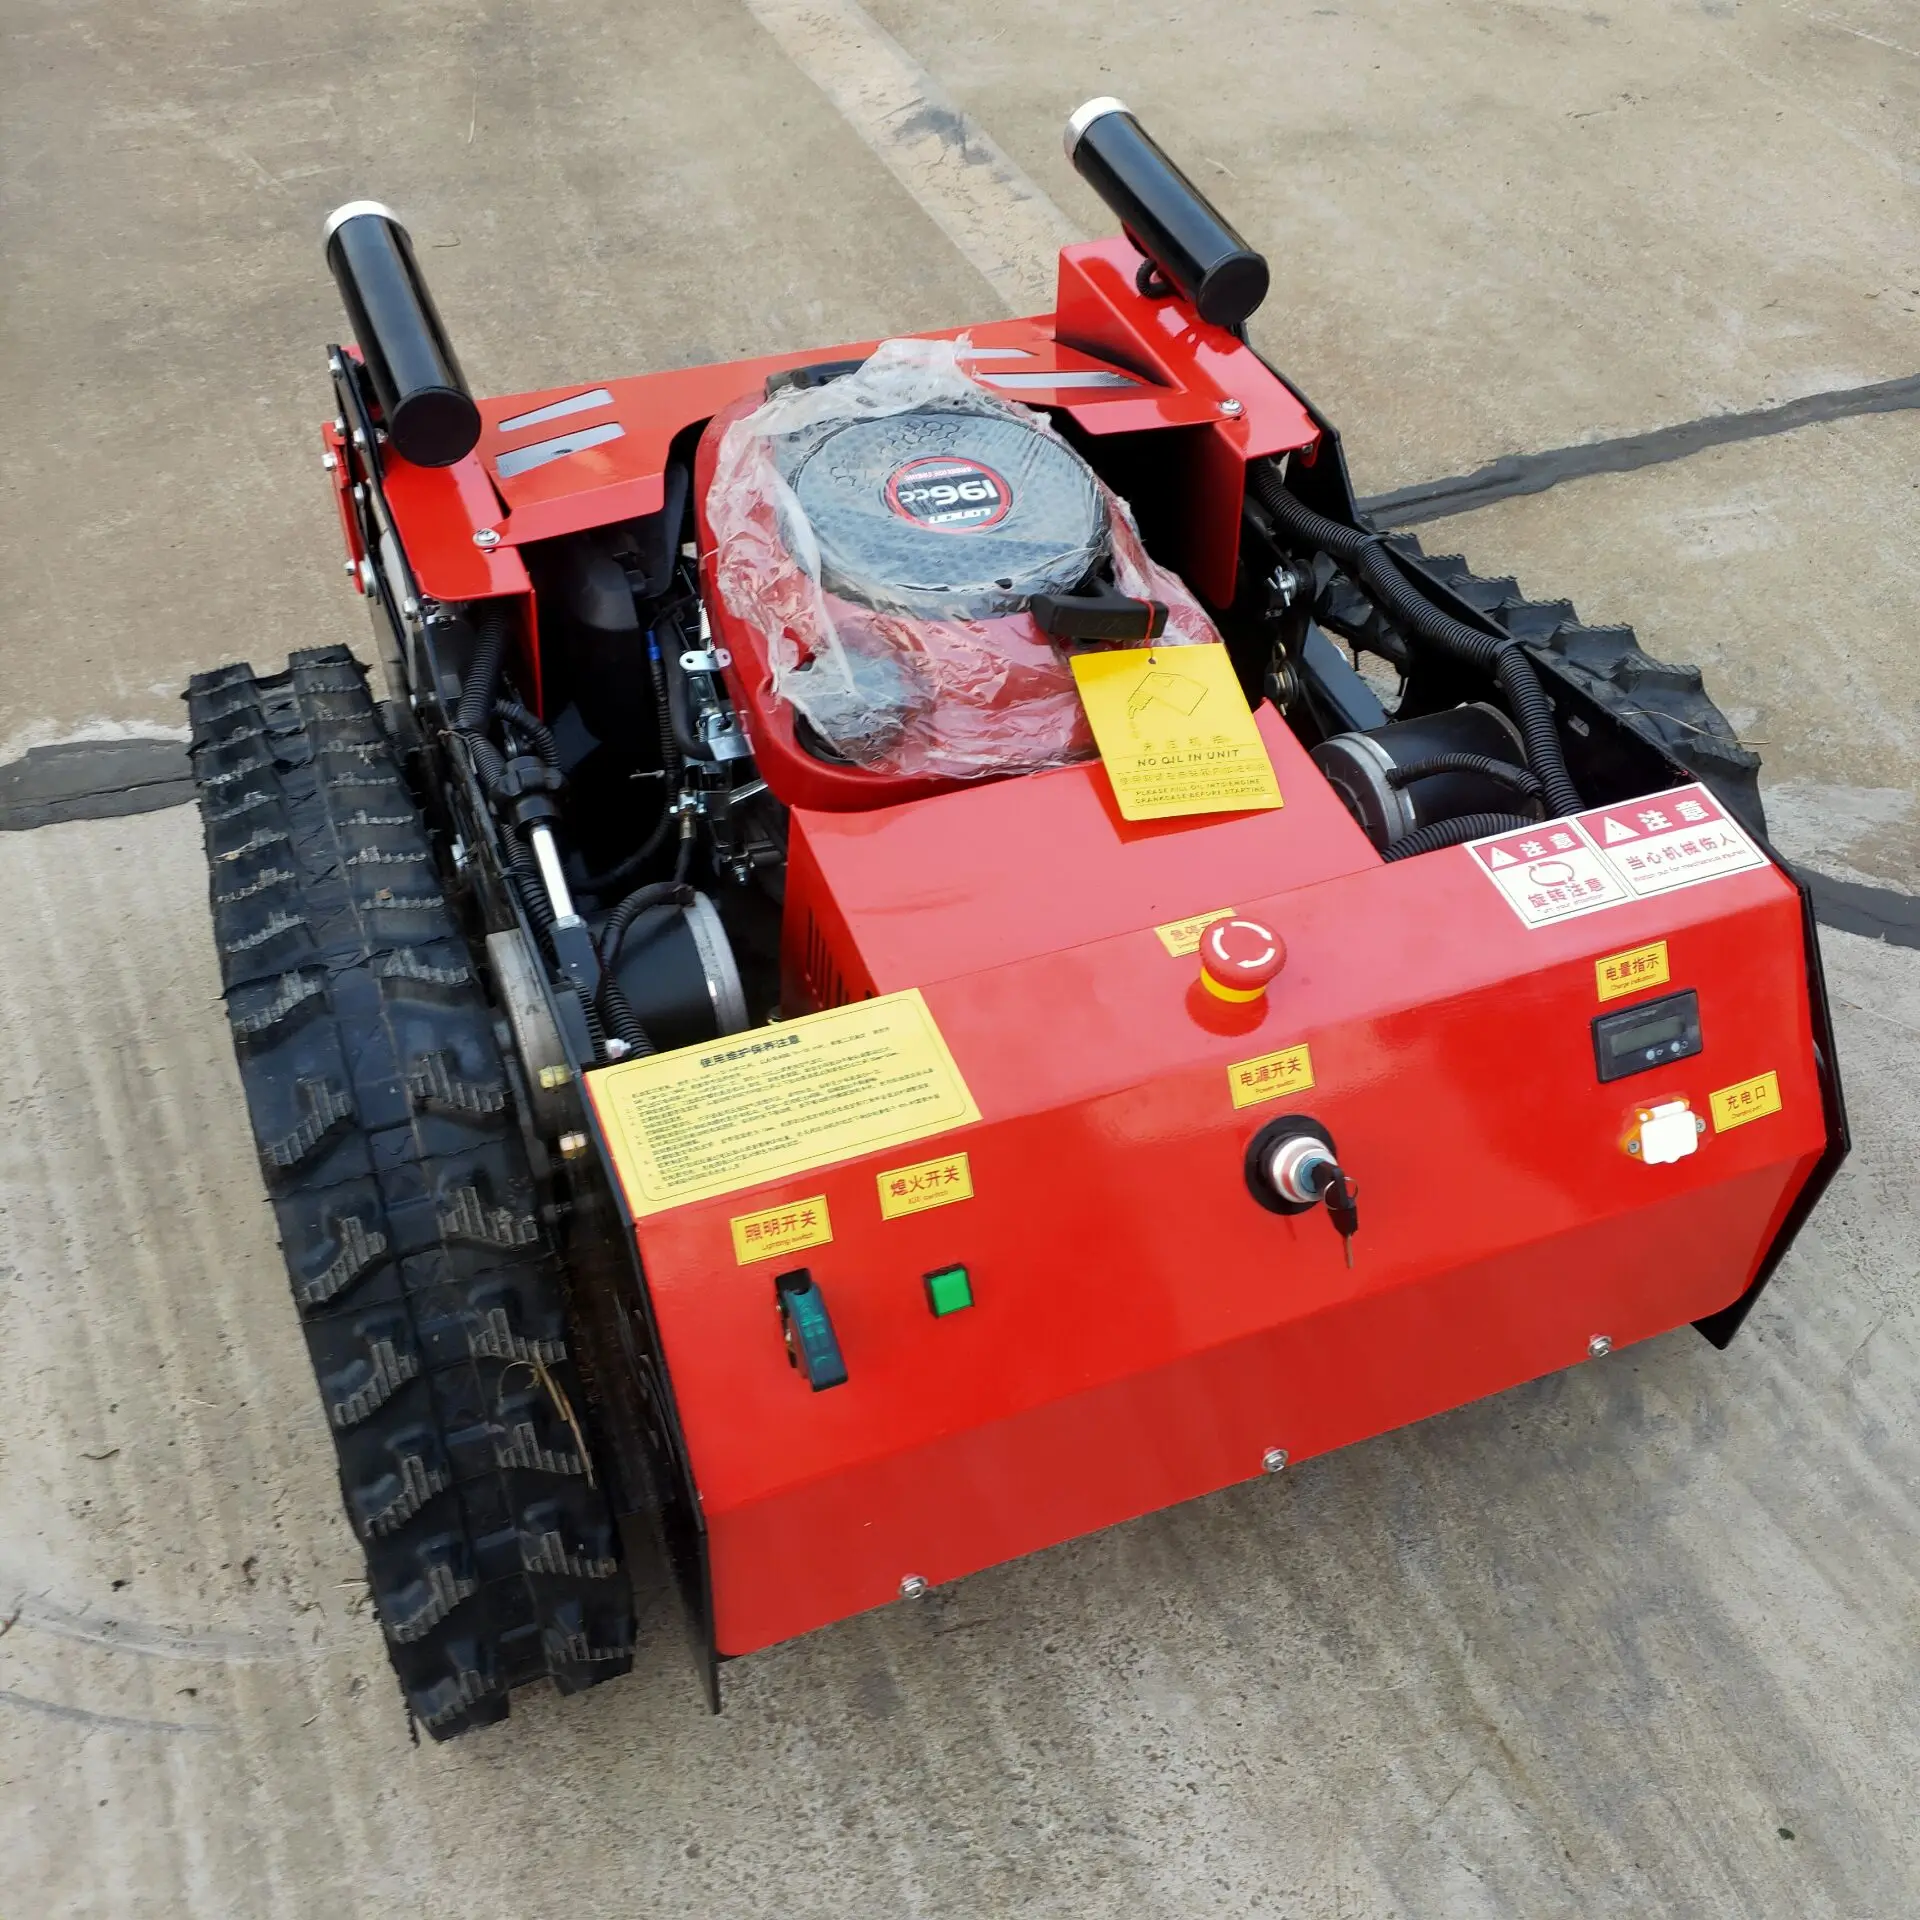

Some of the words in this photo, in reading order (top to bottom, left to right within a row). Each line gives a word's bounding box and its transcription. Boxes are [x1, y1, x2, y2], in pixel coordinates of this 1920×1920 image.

[898, 479, 999, 506] 196cc
[1137, 757, 1157, 767] NO
[1161, 755, 1184, 765] OIL
[1188, 753, 1202, 763] IN
[1206, 749, 1240, 761] UNIT
[1135, 787, 1168, 796] PLEASE
[1206, 780, 1226, 789] INTO
[1227, 778, 1261, 787] ENGINE
[1135, 793, 1187, 804] CRANKCASE
[1189, 790, 1221, 799] BEFORE
[1637, 799, 1709, 832] 注意
[1519, 832, 1576, 858] 注意
[1626, 832, 1736, 870] 当心机械伤人
[1527, 877, 1605, 908] 旋转注意
[1606, 953, 1659, 981] 电量指示
[1239, 1056, 1303, 1087] 电源开关
[1725, 1085, 1766, 1112] 充电口
[890, 1164, 960, 1198] 熄火开关
[744, 1209, 817, 1243] 照明开关
